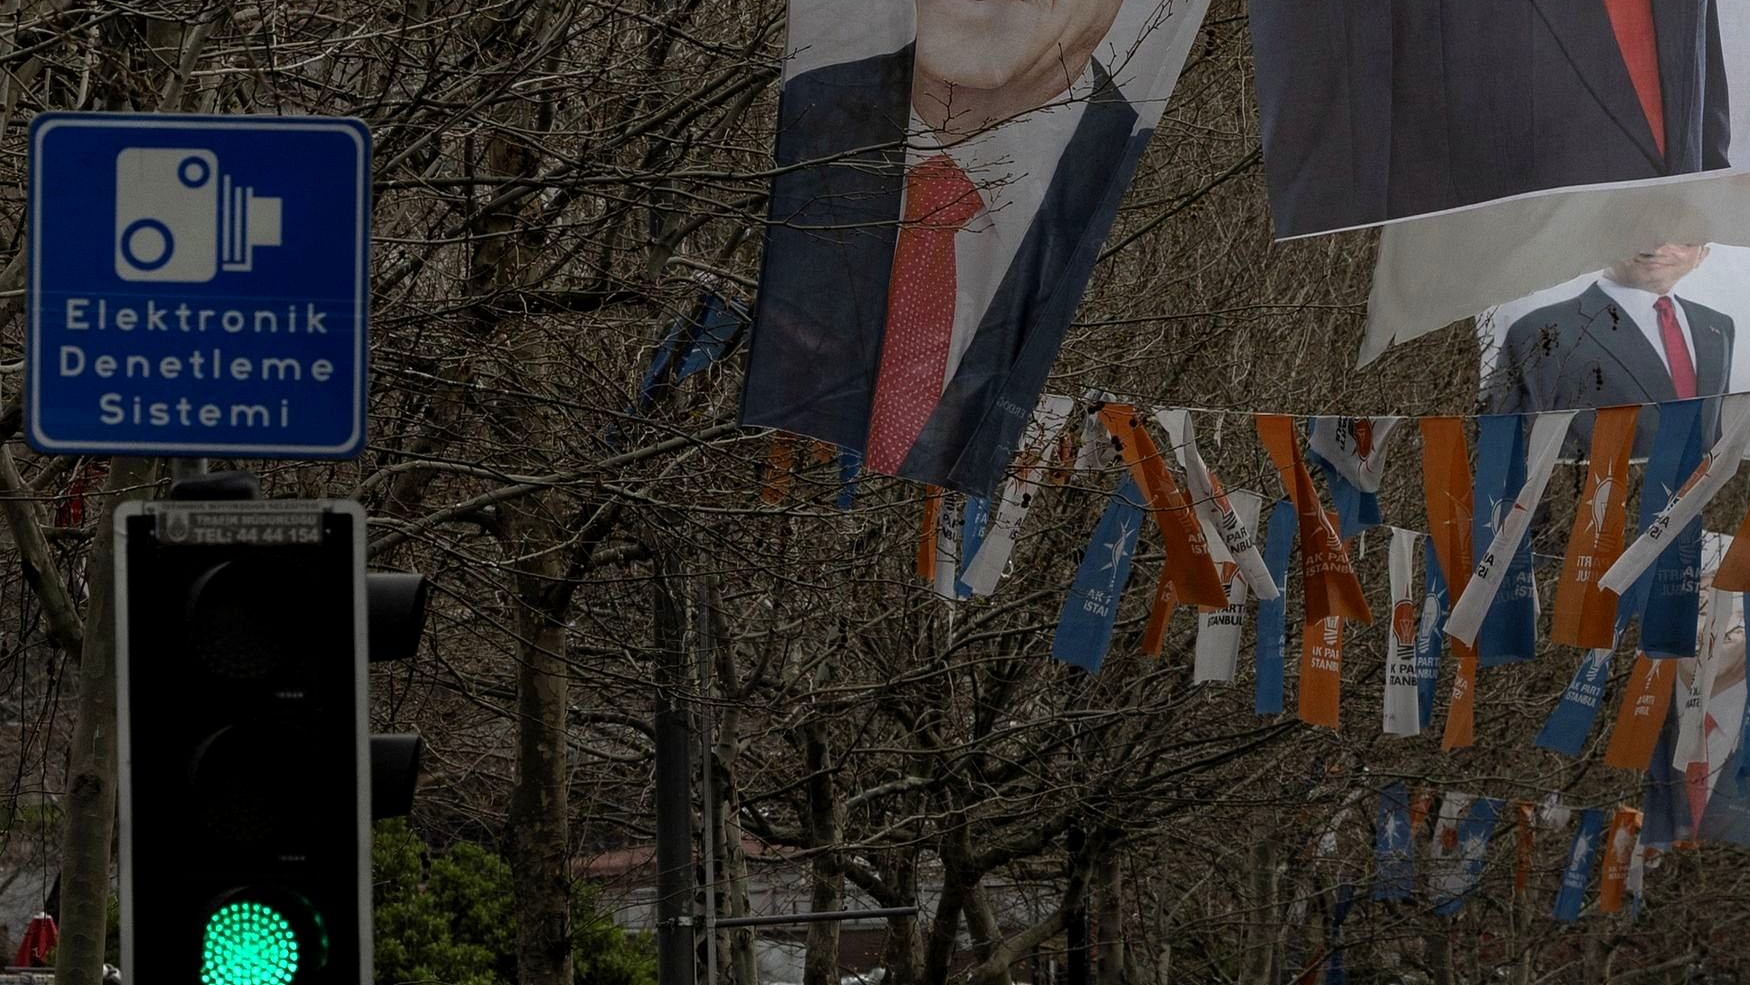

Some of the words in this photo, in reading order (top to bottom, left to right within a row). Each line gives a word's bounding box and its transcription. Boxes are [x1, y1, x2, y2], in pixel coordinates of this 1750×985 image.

[66, 299, 329, 335] Elektronik
[59, 346, 335, 383] Denetleme
[99, 394, 290, 428] Sistemi
[193, 528, 233, 543] TEL:
[236, 528, 259, 543] 44
[262, 528, 283, 543] 44
[288, 528, 320, 543] 154
